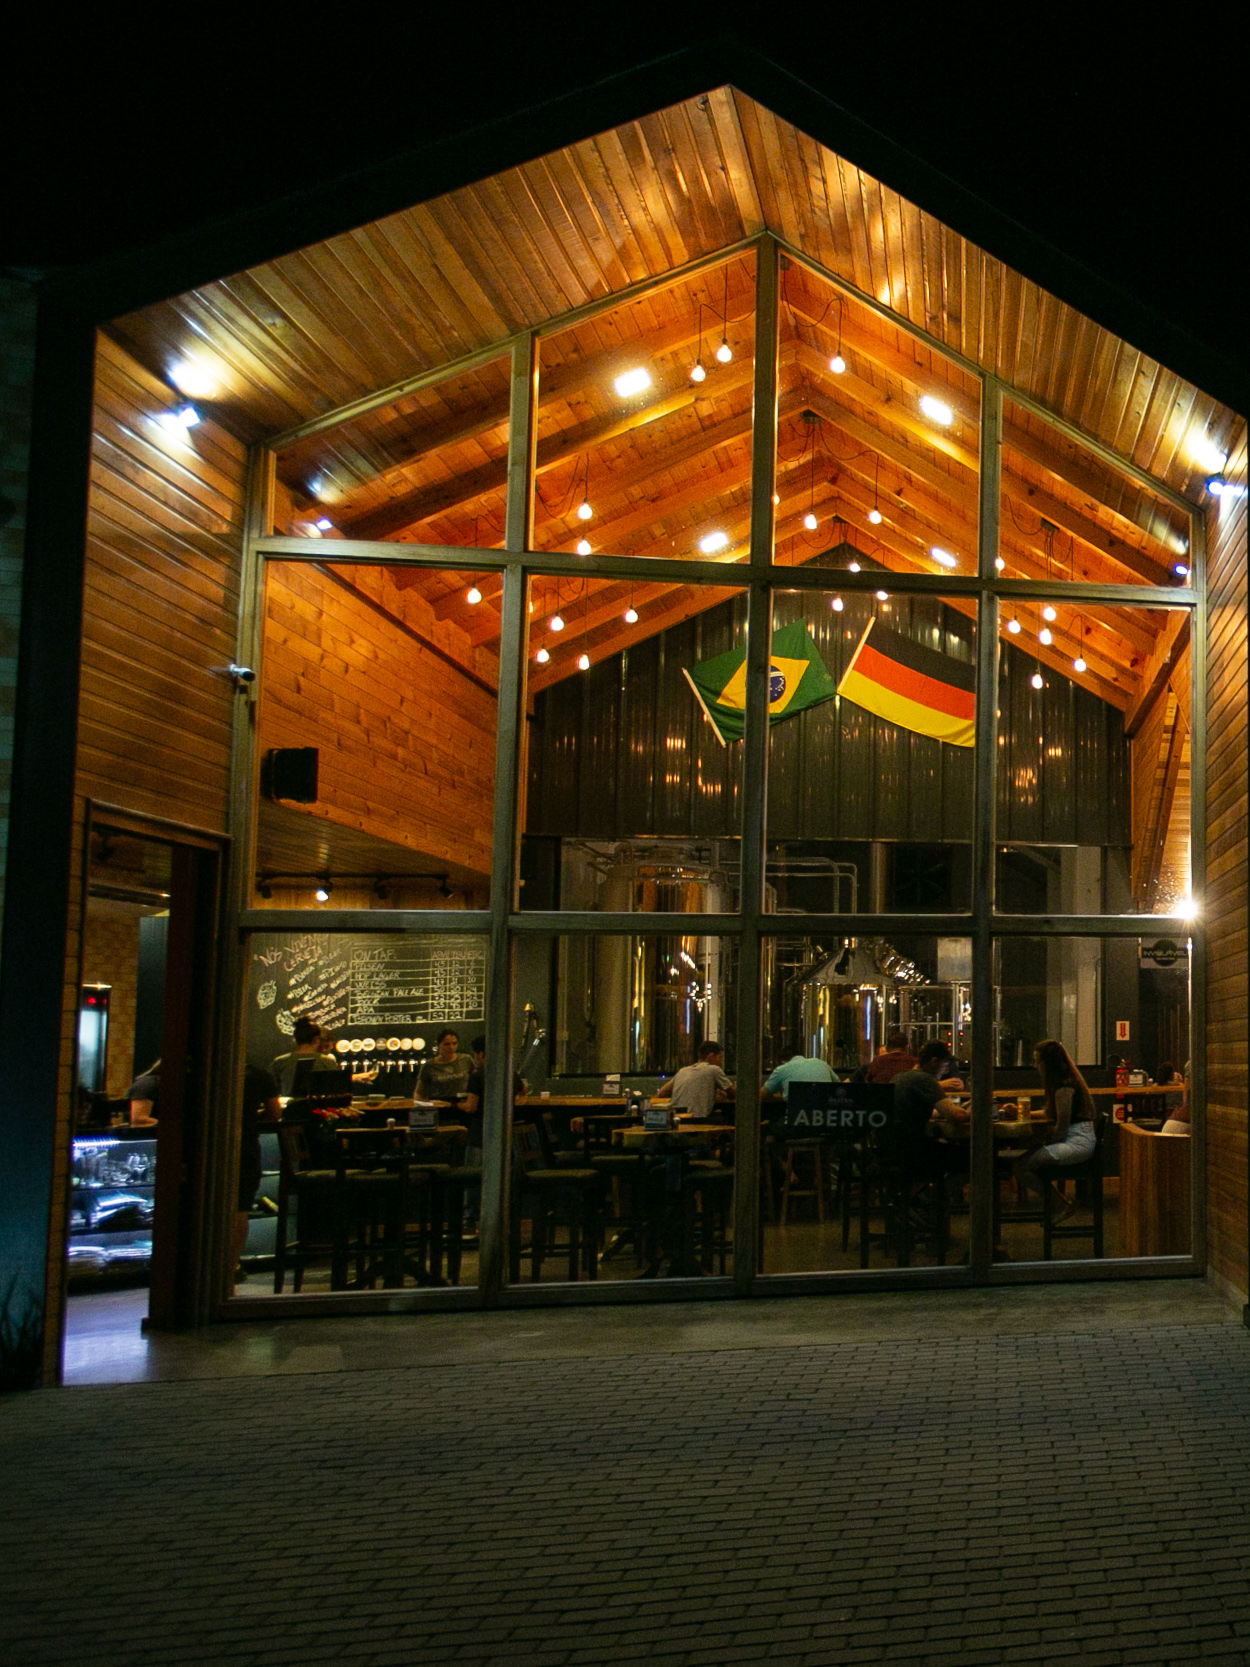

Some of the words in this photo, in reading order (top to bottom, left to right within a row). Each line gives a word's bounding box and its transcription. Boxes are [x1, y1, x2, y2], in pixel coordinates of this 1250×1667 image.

[354, 949, 372, 961] ON
[355, 971, 371, 980] HOP
[410, 988, 425, 996] ALE
[356, 1006, 375, 1014] APA
[793, 1109, 888, 1128] ABERTO
